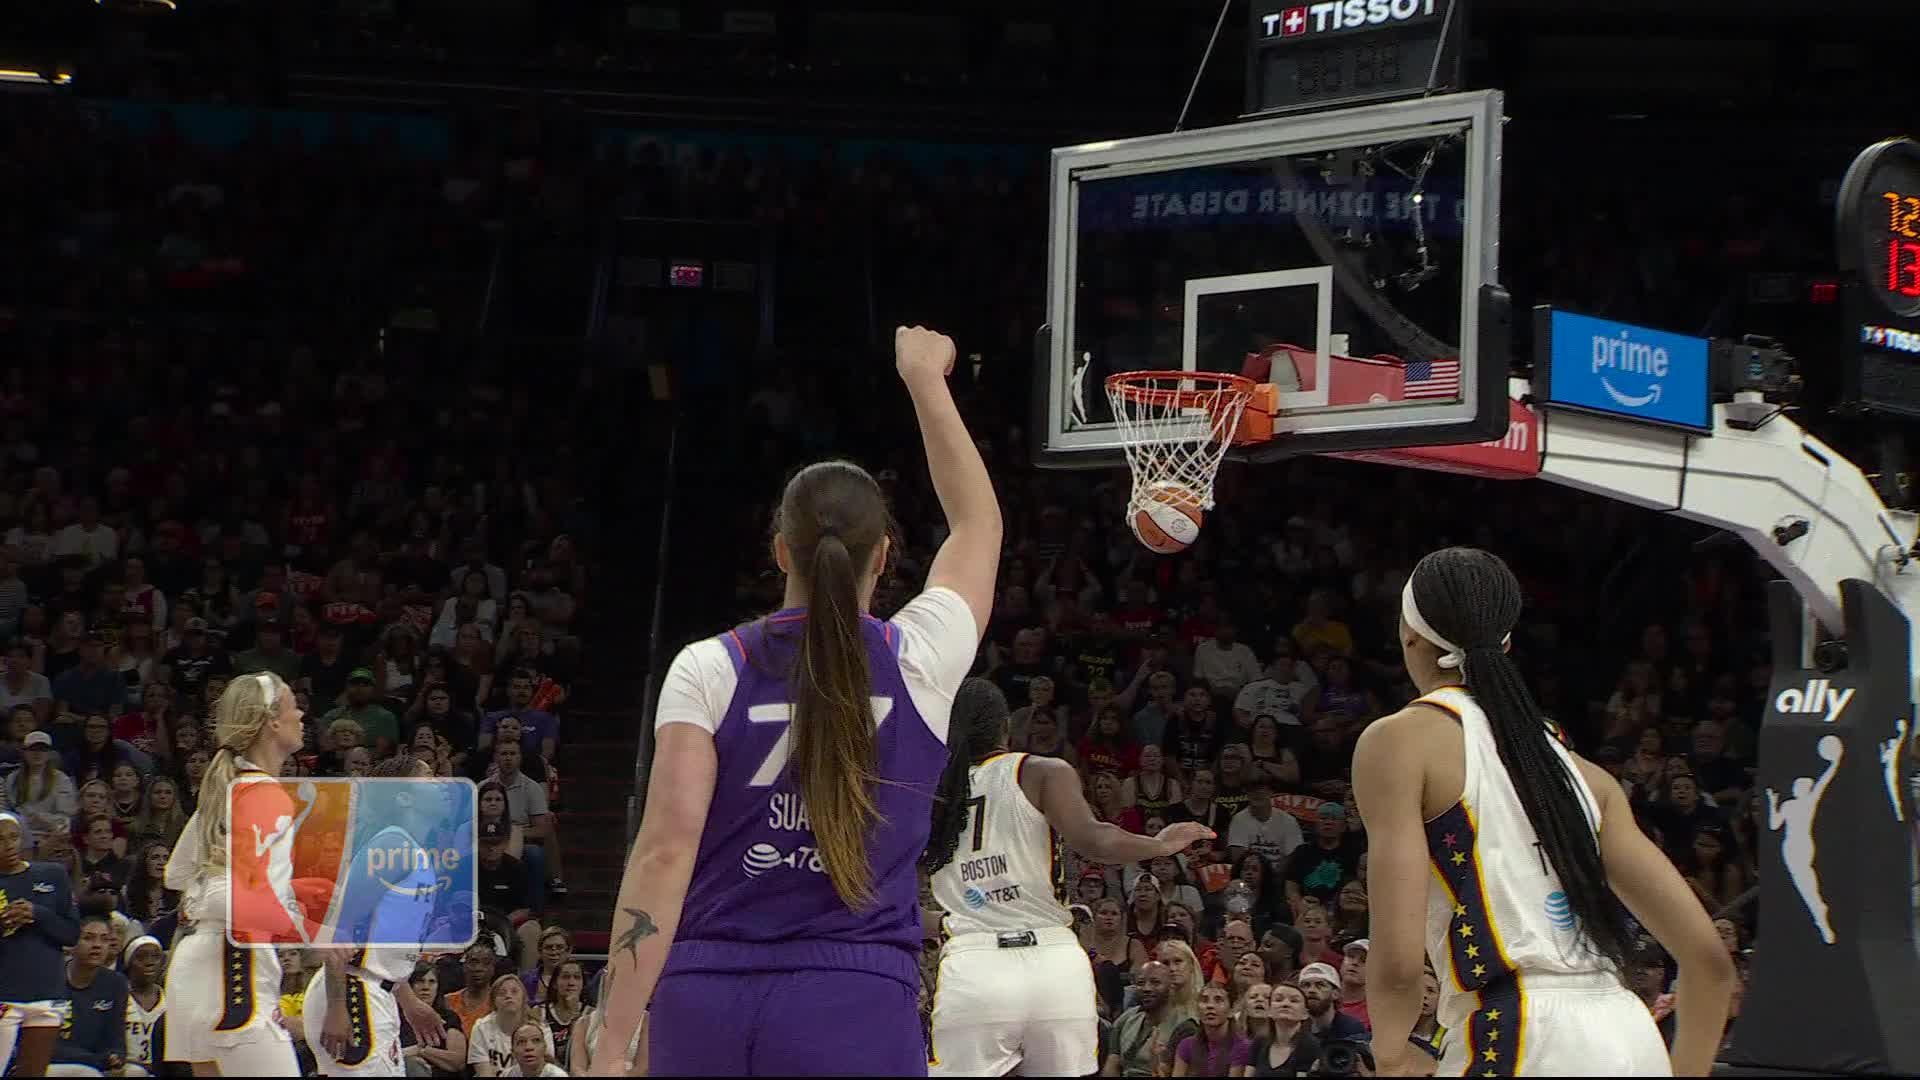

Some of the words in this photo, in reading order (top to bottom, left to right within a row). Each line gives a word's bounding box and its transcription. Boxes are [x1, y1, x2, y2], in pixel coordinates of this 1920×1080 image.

[1591, 328, 1670, 378] prime
[1775, 679, 1856, 722] ally
[769, 792, 812, 831] SUA
[960, 853, 1008, 882] BOSTON
[984, 884, 1020, 904] AT&T
